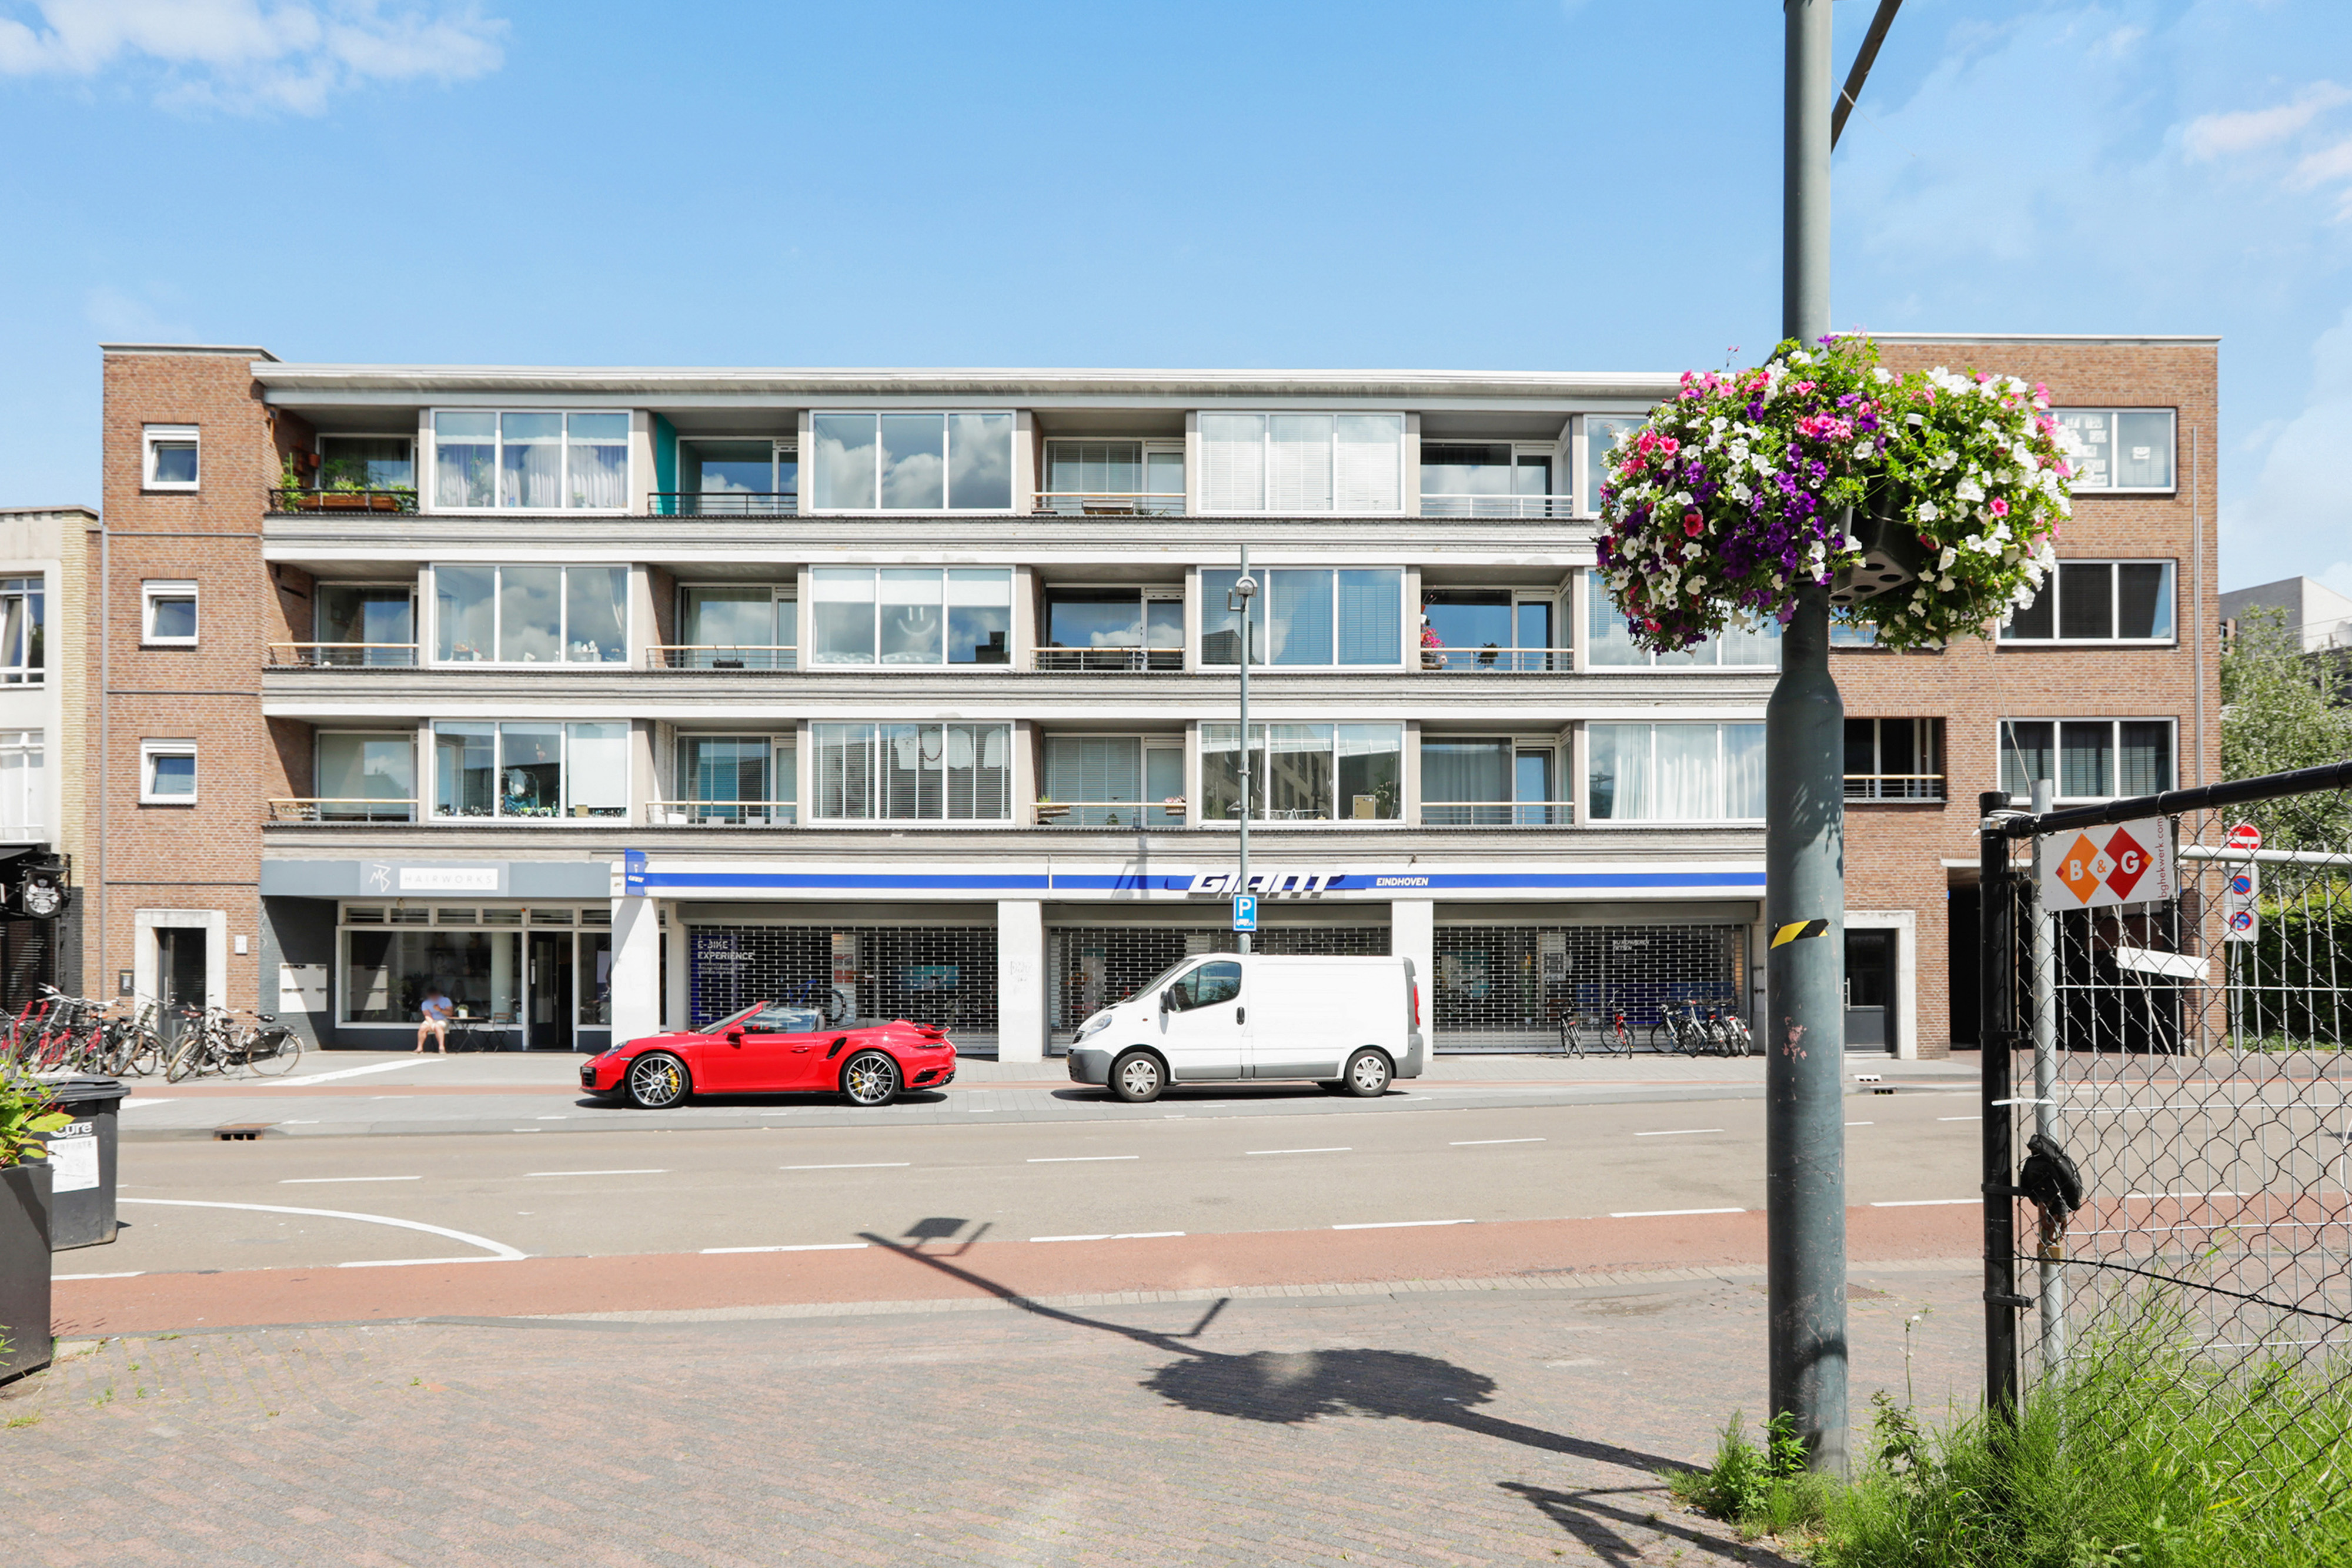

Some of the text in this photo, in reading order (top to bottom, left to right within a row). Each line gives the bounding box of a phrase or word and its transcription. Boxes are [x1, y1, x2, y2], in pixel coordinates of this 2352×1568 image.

[2154, 817, 2169, 898] bghekwerk.com
[404, 875, 493, 884] HAIRWORKS
[1188, 871, 1347, 893] GIANT
[1376, 877, 1429, 886] EINDHOVEN
[1238, 898, 1252, 917] P
[697, 951, 754, 959] EXPERIENCE
